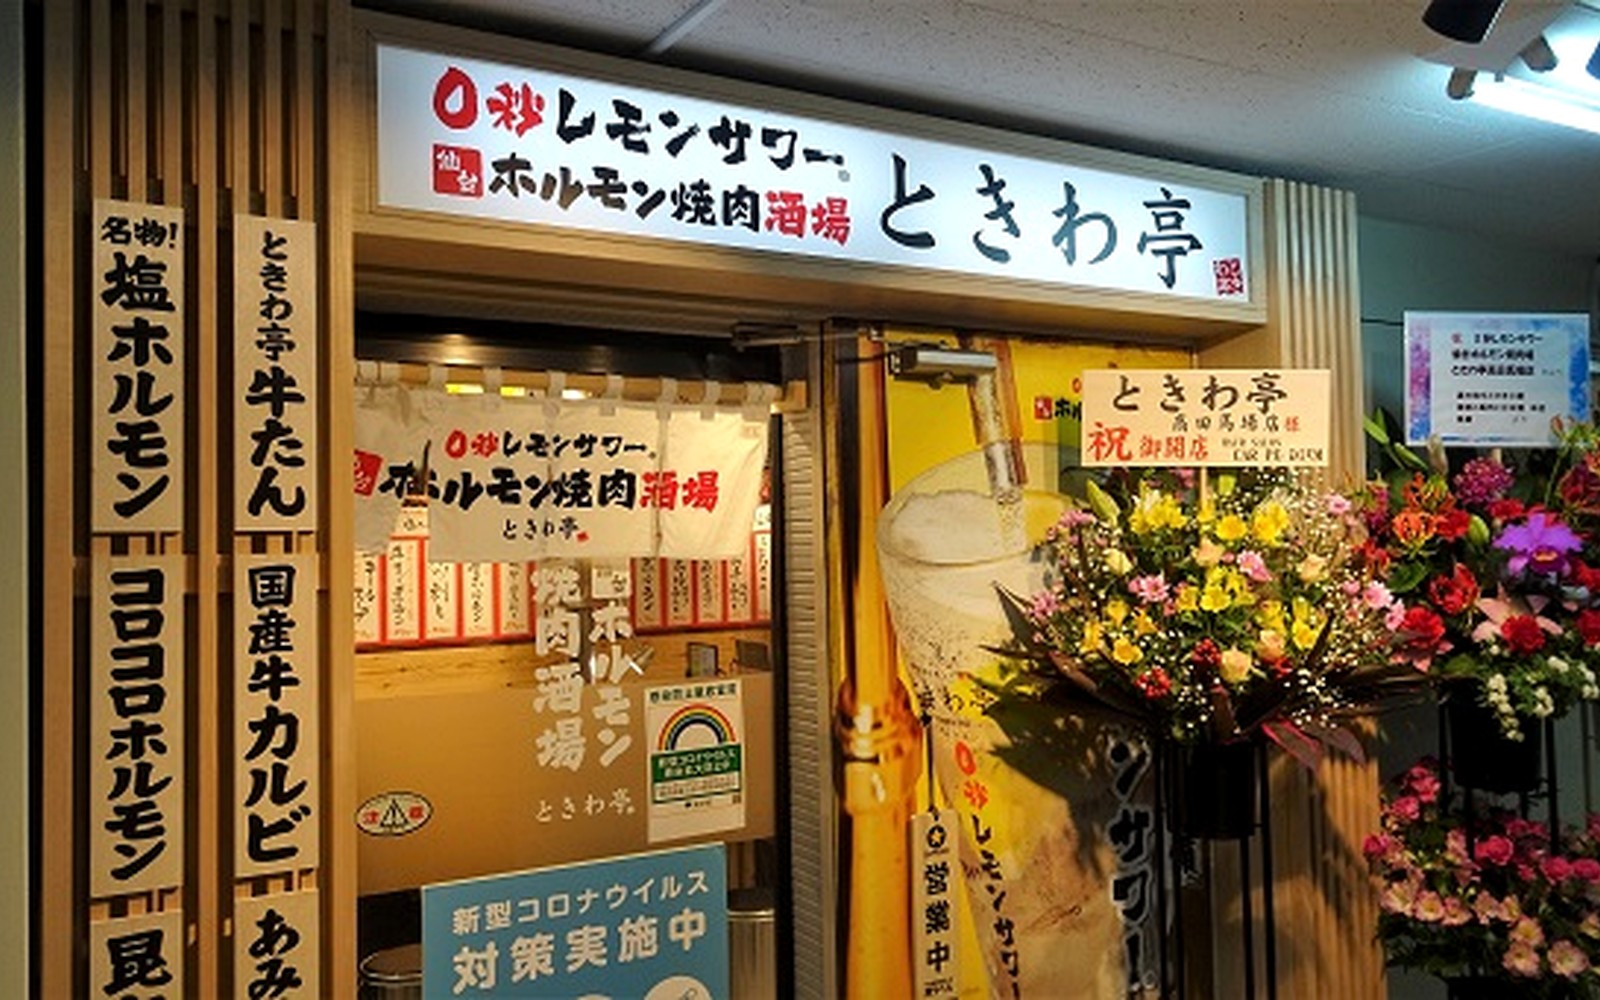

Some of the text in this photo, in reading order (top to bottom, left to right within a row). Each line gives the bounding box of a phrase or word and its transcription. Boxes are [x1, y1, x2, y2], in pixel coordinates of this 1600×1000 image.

[489, 152, 851, 246] ホルモン焼肉酒場
[880, 152, 1203, 290] ときわ亭
[100, 251, 176, 518] 塩ホルモン
[1112, 371, 1288, 413] ときわ亭
[1088, 421, 1133, 461] 祝
[1172, 413, 1280, 433] 高田馬場店
[378, 460, 719, 513] ホルモン焼肉酒場
[502, 517, 579, 542] ときわ亭
[104, 567, 173, 881] コロコロホルモン
[245, 565, 312, 862] 国産牛カルビ
[535, 788, 631, 822] ときわ亭
[452, 871, 710, 936] 新型コロナウイルス
[924, 861, 951, 973] 営業中
[452, 907, 707, 995] 対策実施中
